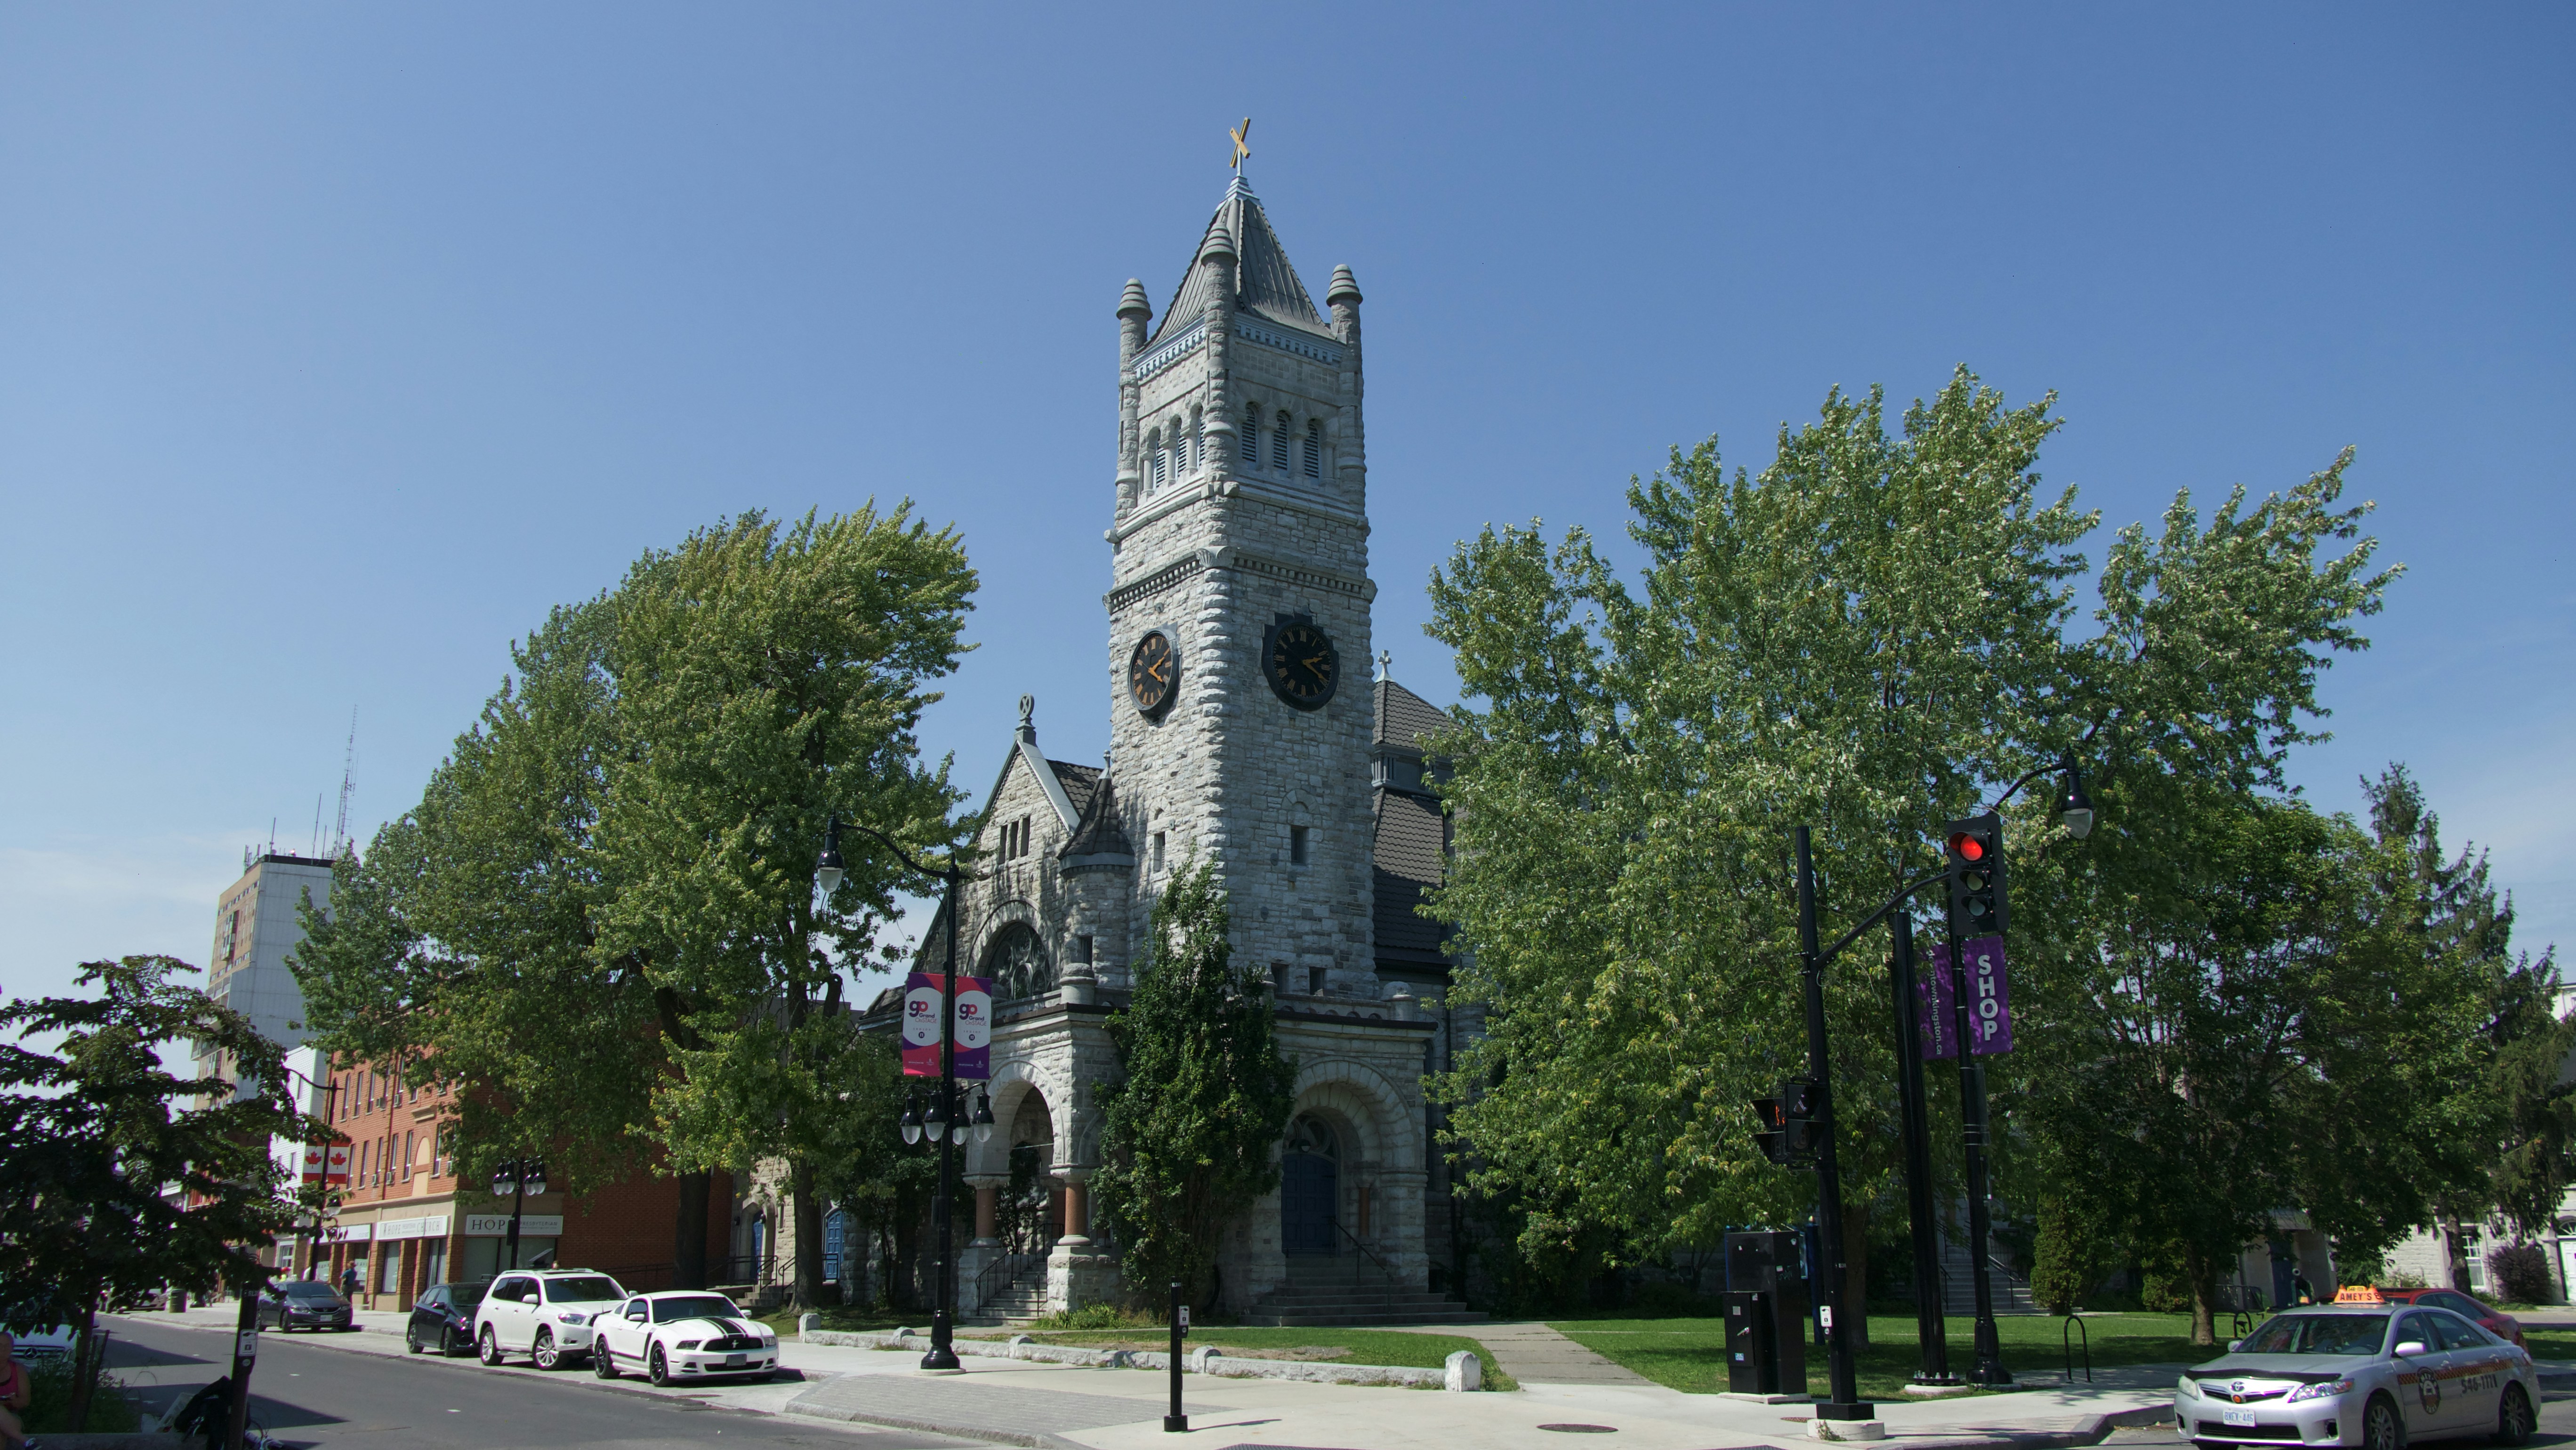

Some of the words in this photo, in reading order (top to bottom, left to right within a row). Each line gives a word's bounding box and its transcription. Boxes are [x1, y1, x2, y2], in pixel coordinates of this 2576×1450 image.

[1928, 949, 1942, 1055] dontownkingston.ca
[1977, 954, 1998, 1041] SHOP
[909, 1000, 928, 1017] go
[959, 1003, 978, 1020] go
[387, 1224, 401, 1235] HOPE
[472, 1219, 506, 1230] HOP
[2340, 1293, 2372, 1301] AMEY'S
[2461, 1374, 2497, 1394] 546-1111
